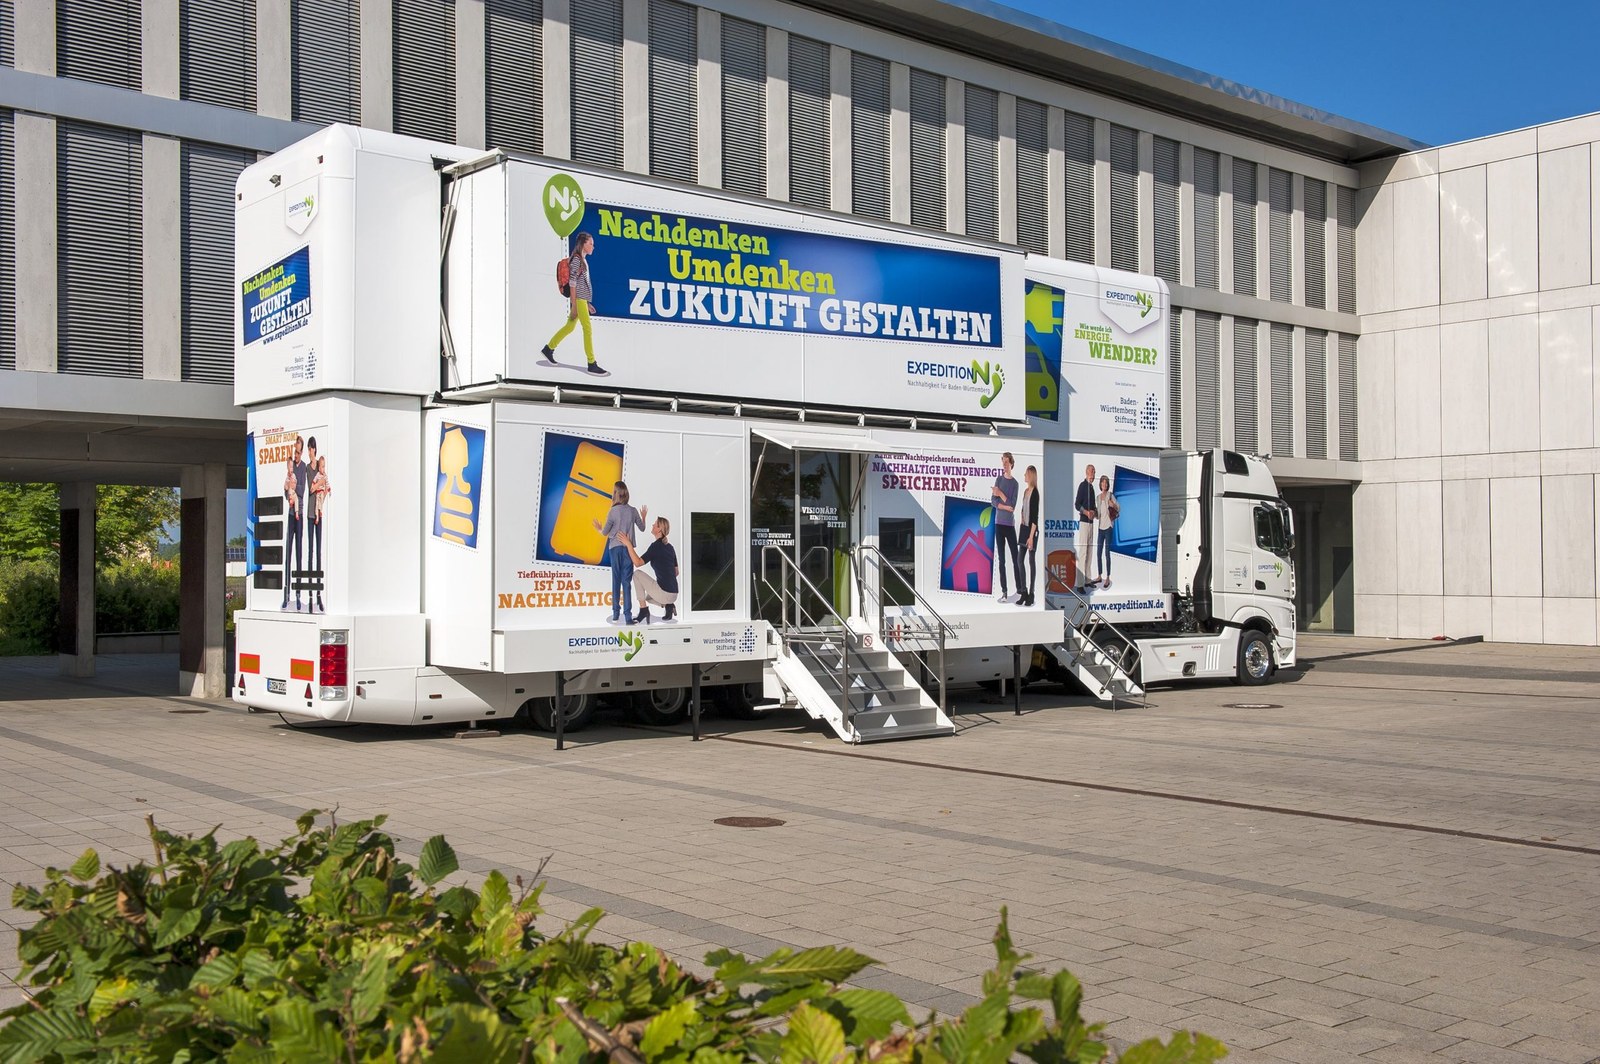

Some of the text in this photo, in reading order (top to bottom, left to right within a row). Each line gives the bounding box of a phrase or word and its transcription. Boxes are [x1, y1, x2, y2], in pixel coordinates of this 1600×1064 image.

[598, 208, 770, 256] Nachdenken
[243, 265, 284, 296] Nachdenken
[667, 248, 836, 295] Umdenken
[259, 273, 297, 301] Umdenken
[250, 287, 292, 324] ZUKUNFT
[629, 278, 992, 343] ZUKUNFT GESTALTEN
[260, 296, 310, 336] GESTALTEN
[1074, 328, 1112, 343] ENERGIE-
[1079, 322, 1089, 330] Wie
[1090, 324, 1104, 332] werde
[1088, 341, 1158, 366] WENDER?
[1114, 415, 1137, 427] Stiftung
[905, 454, 961, 464] Nachtspeicherofen
[872, 462, 940, 475] NACHHALTIGE
[882, 474, 967, 492] SPEICHERN?
[1044, 520, 1080, 531] SPAREN
[517, 570, 574, 580] Tiefkühlpizza:
[534, 579, 581, 591] IST DAS
